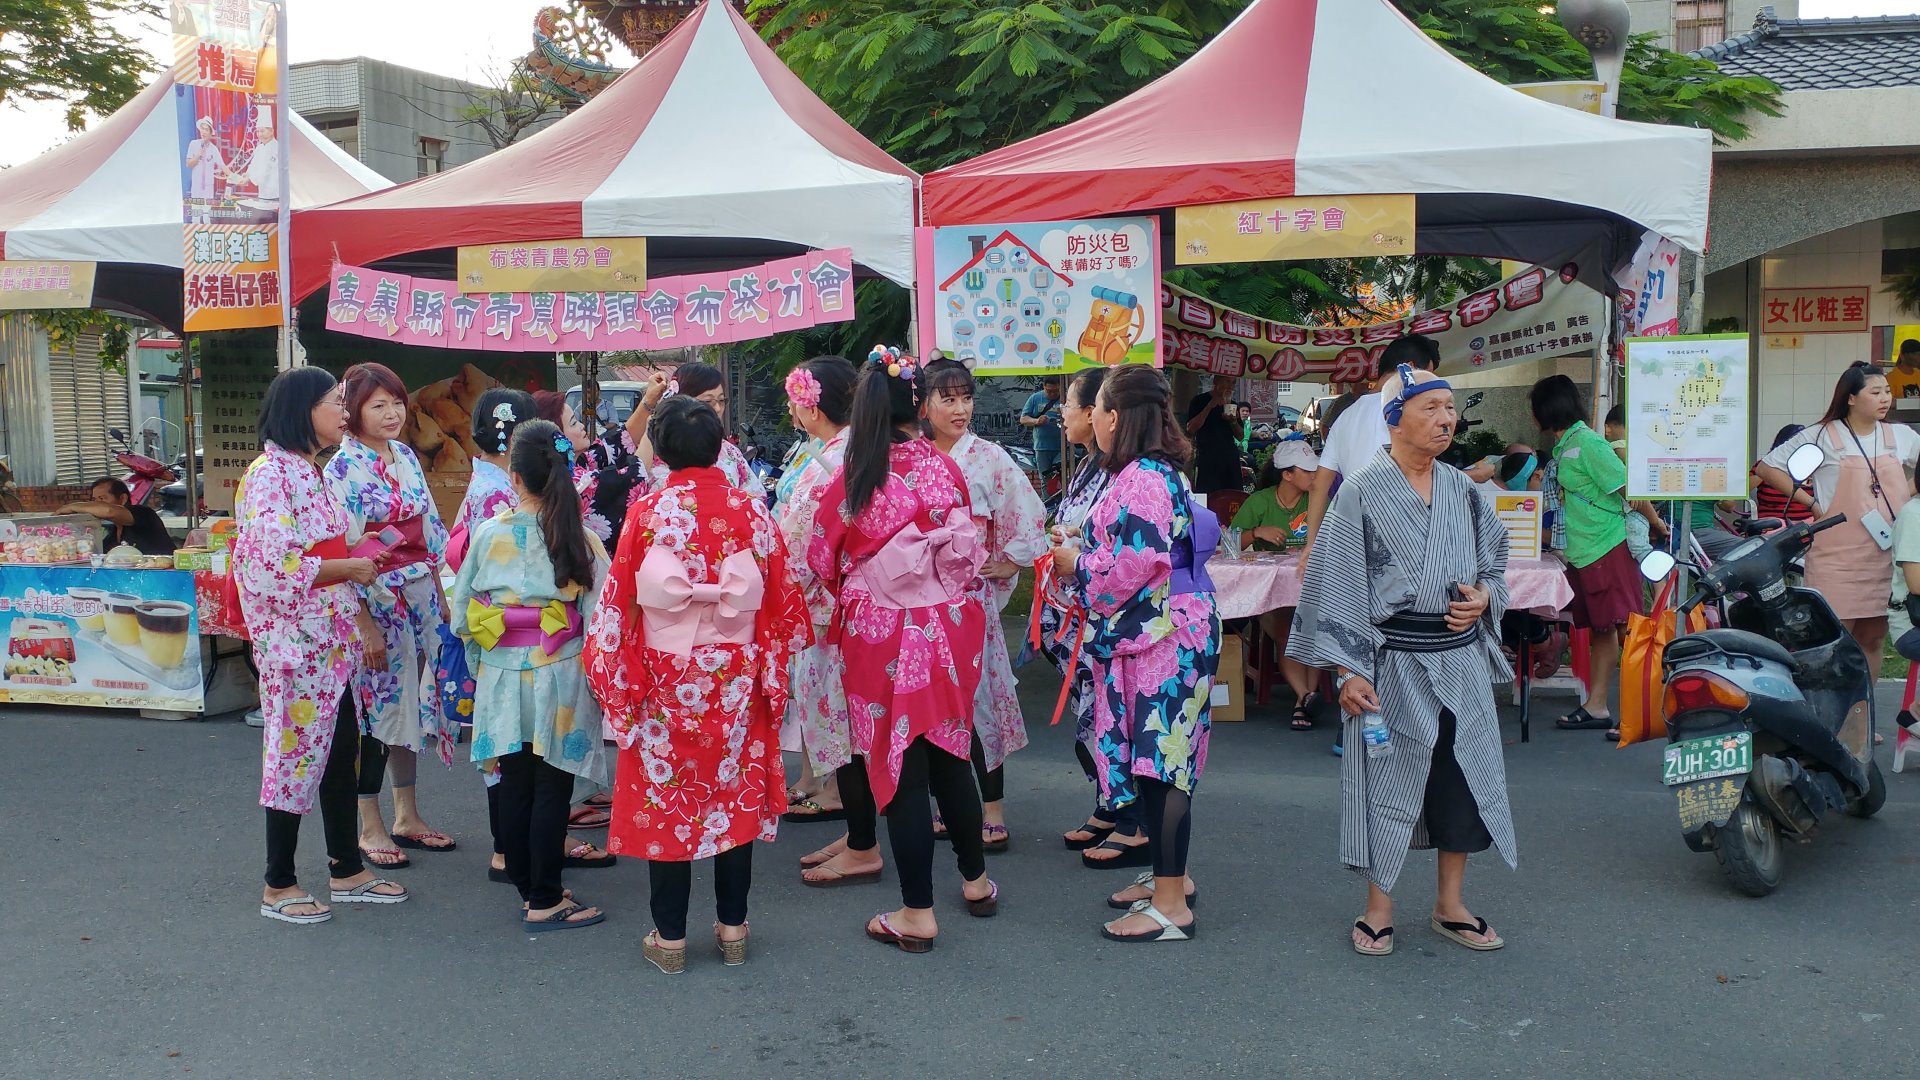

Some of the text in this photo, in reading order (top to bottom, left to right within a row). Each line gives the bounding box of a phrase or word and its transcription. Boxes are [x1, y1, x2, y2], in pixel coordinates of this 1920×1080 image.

[197, 42, 257, 87] 推薦
[1237, 206, 1346, 234] 紅十字會
[193, 230, 270, 263] 溪口名產
[489, 246, 612, 269] 布袋青農分會
[1067, 232, 1130, 256] 防災包
[1061, 255, 1138, 273] 準備好了嗎?
[188, 271, 280, 309] 永芳鳥仔餅
[328, 259, 851, 346] 嘉義縣市青農聯誼會布袋分會
[1767, 295, 1865, 324] 女化粧室
[1489, 315, 1589, 346] 嘉義縣社會局 廣告
[1490, 331, 1594, 362] 嘉義縣紅十字會承辦
[1665, 745, 1748, 778] ZUH-301
